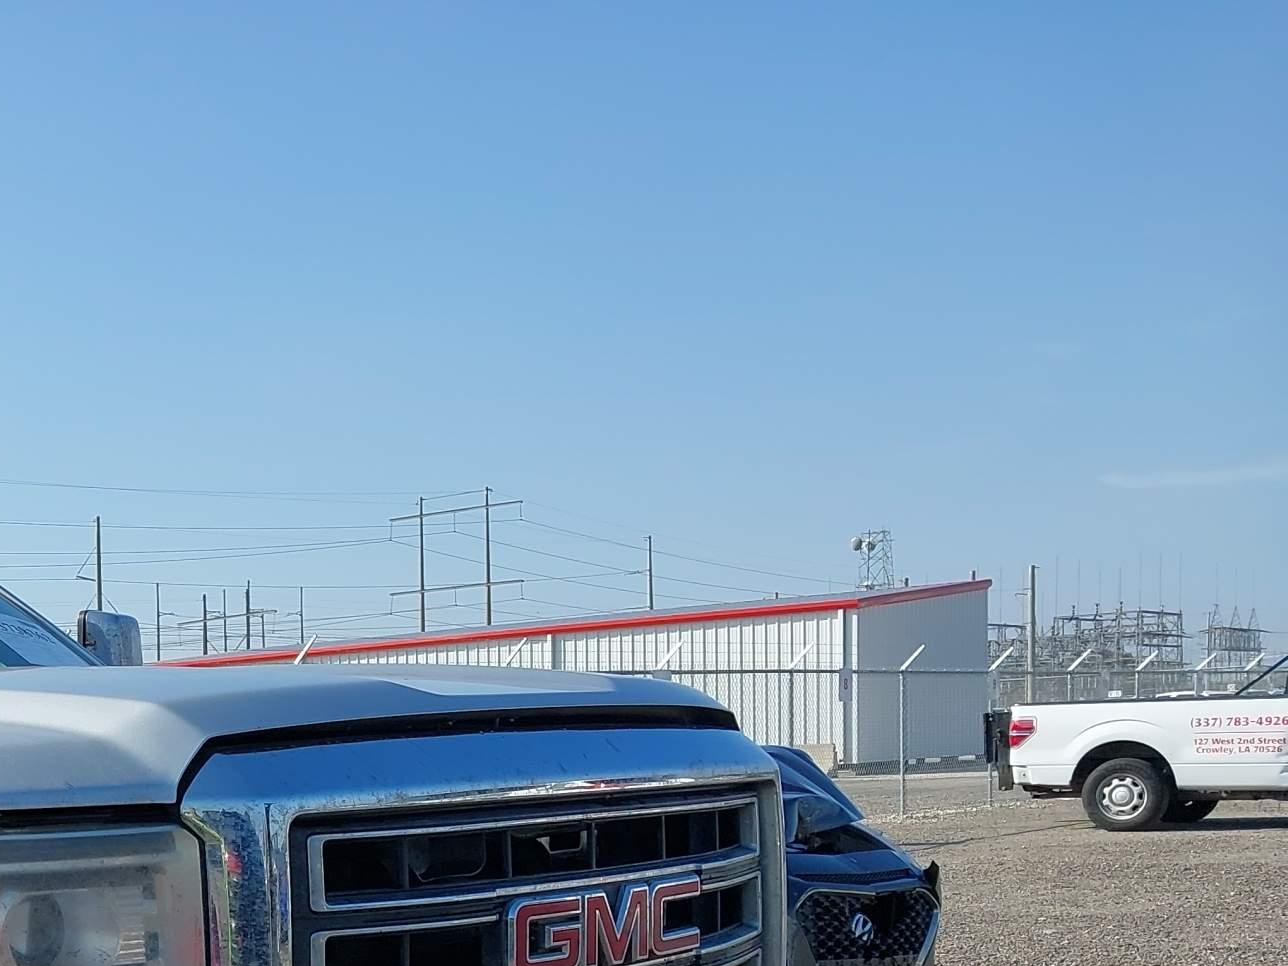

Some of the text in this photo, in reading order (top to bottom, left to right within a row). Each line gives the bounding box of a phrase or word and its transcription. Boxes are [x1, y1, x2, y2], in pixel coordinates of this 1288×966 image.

[1190, 716, 1288, 728] (337) 783-4926
[1194, 737, 1287, 746] 127 West 2nd Street
[1196, 745, 1283, 755] Crowley, LA 70526
